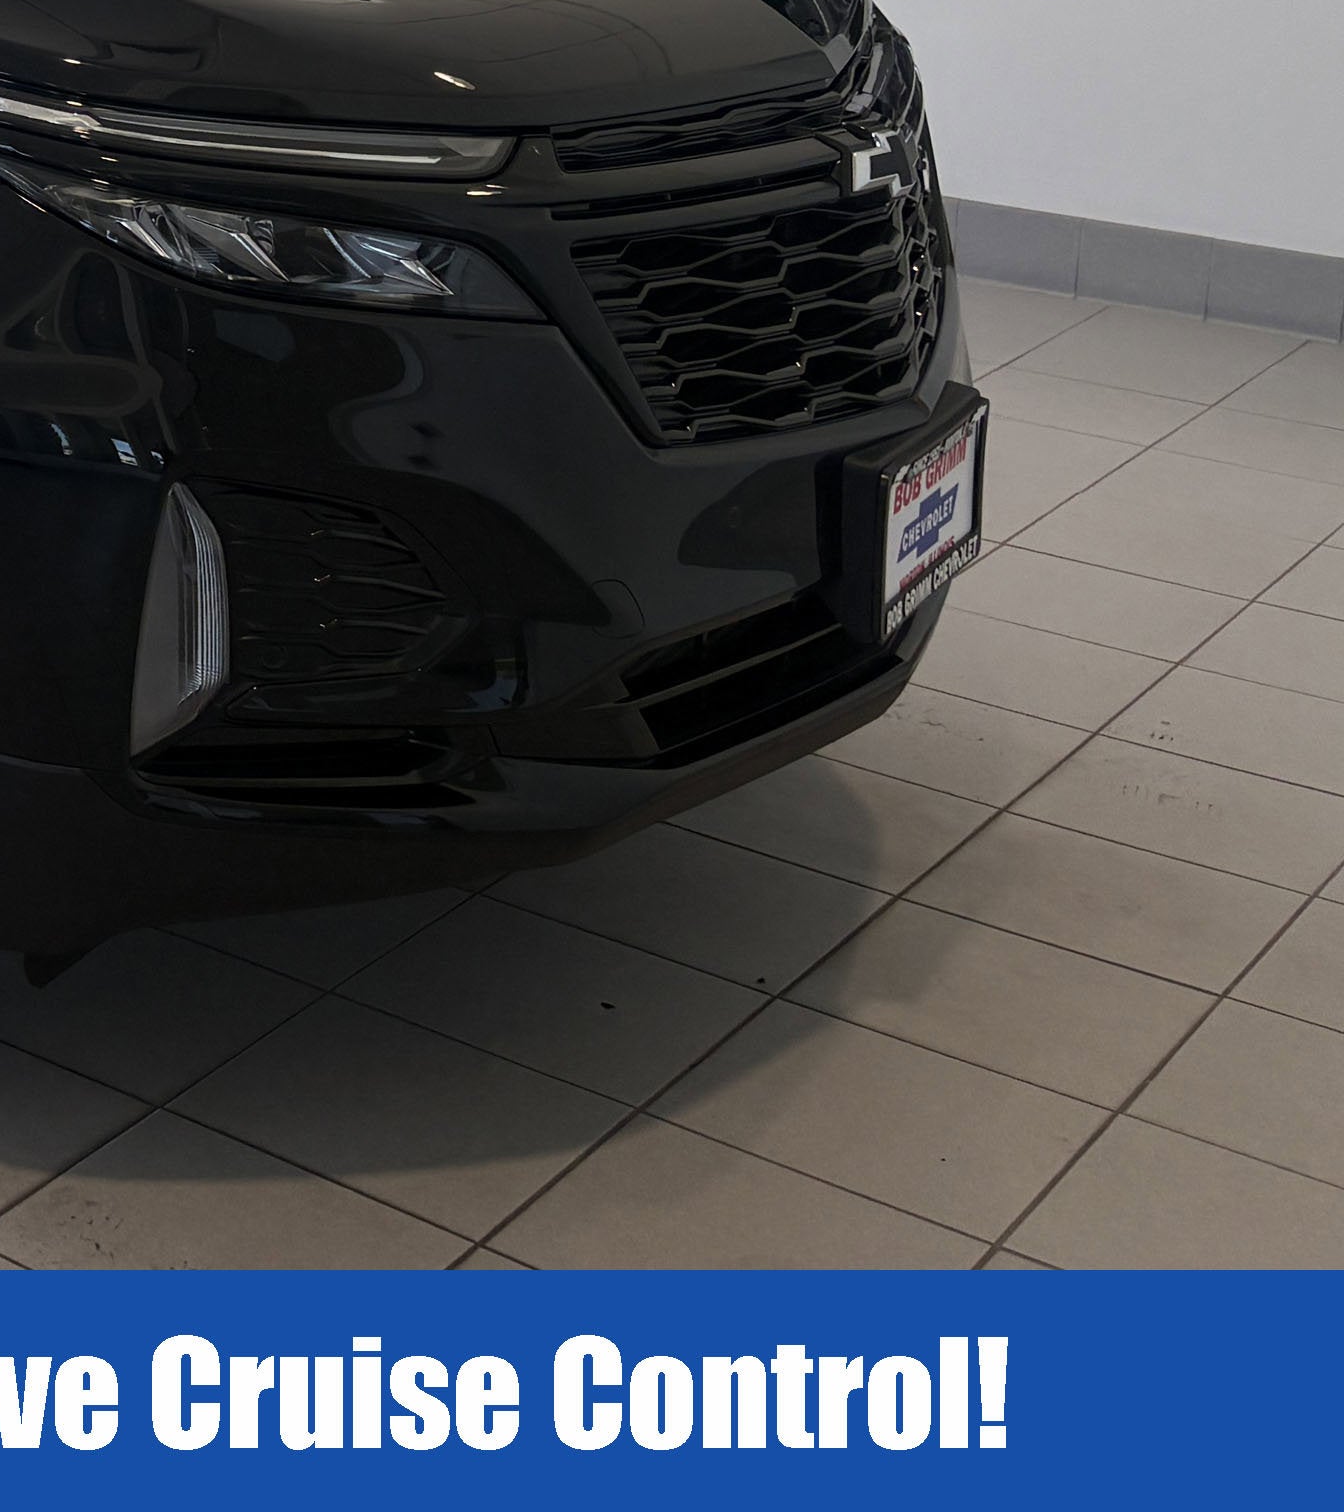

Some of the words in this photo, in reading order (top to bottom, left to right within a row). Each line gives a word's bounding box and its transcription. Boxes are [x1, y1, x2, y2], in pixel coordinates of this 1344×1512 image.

[893, 474, 922, 514] BOB
[926, 438, 968, 489] GRIMM
[902, 496, 954, 550] CHEVROLET
[886, 600, 903, 634] BOB
[904, 573, 932, 617] GRIMM
[933, 534, 978, 590] CHEVROLET
